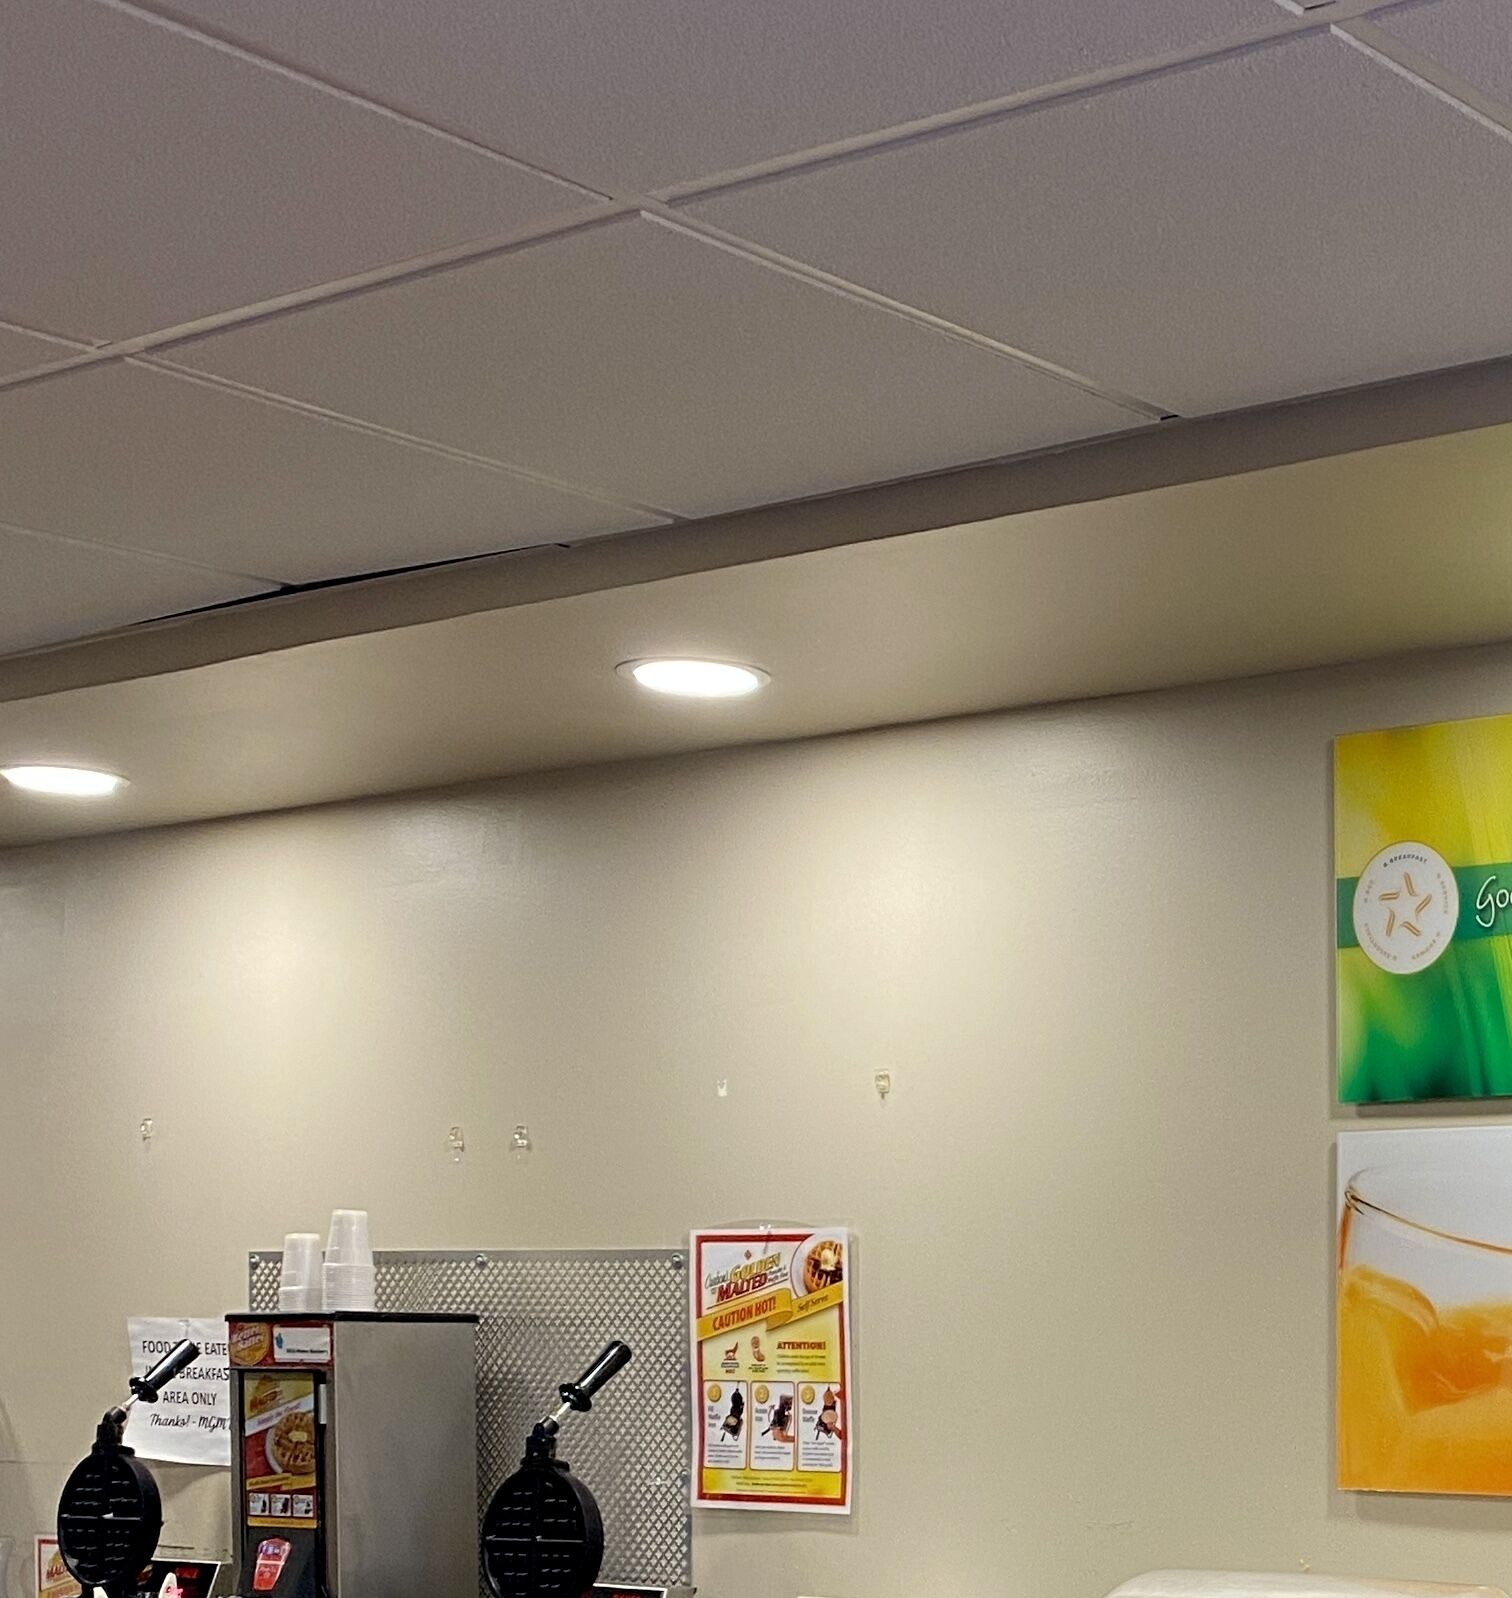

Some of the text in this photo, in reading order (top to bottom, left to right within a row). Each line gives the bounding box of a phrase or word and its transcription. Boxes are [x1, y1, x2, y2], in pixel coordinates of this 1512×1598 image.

[717, 1272, 768, 1303] MALTED
[712, 1296, 777, 1331] CAUTION HOT!
[142, 1341, 171, 1355] FOOD
[205, 1342, 228, 1357] EATE
[776, 1341, 827, 1351] ATTENTION!
[180, 1367, 229, 1381] BREAKFAS
[162, 1391, 218, 1406] AREA ONLY
[150, 1413, 191, 1428] Thanks!
